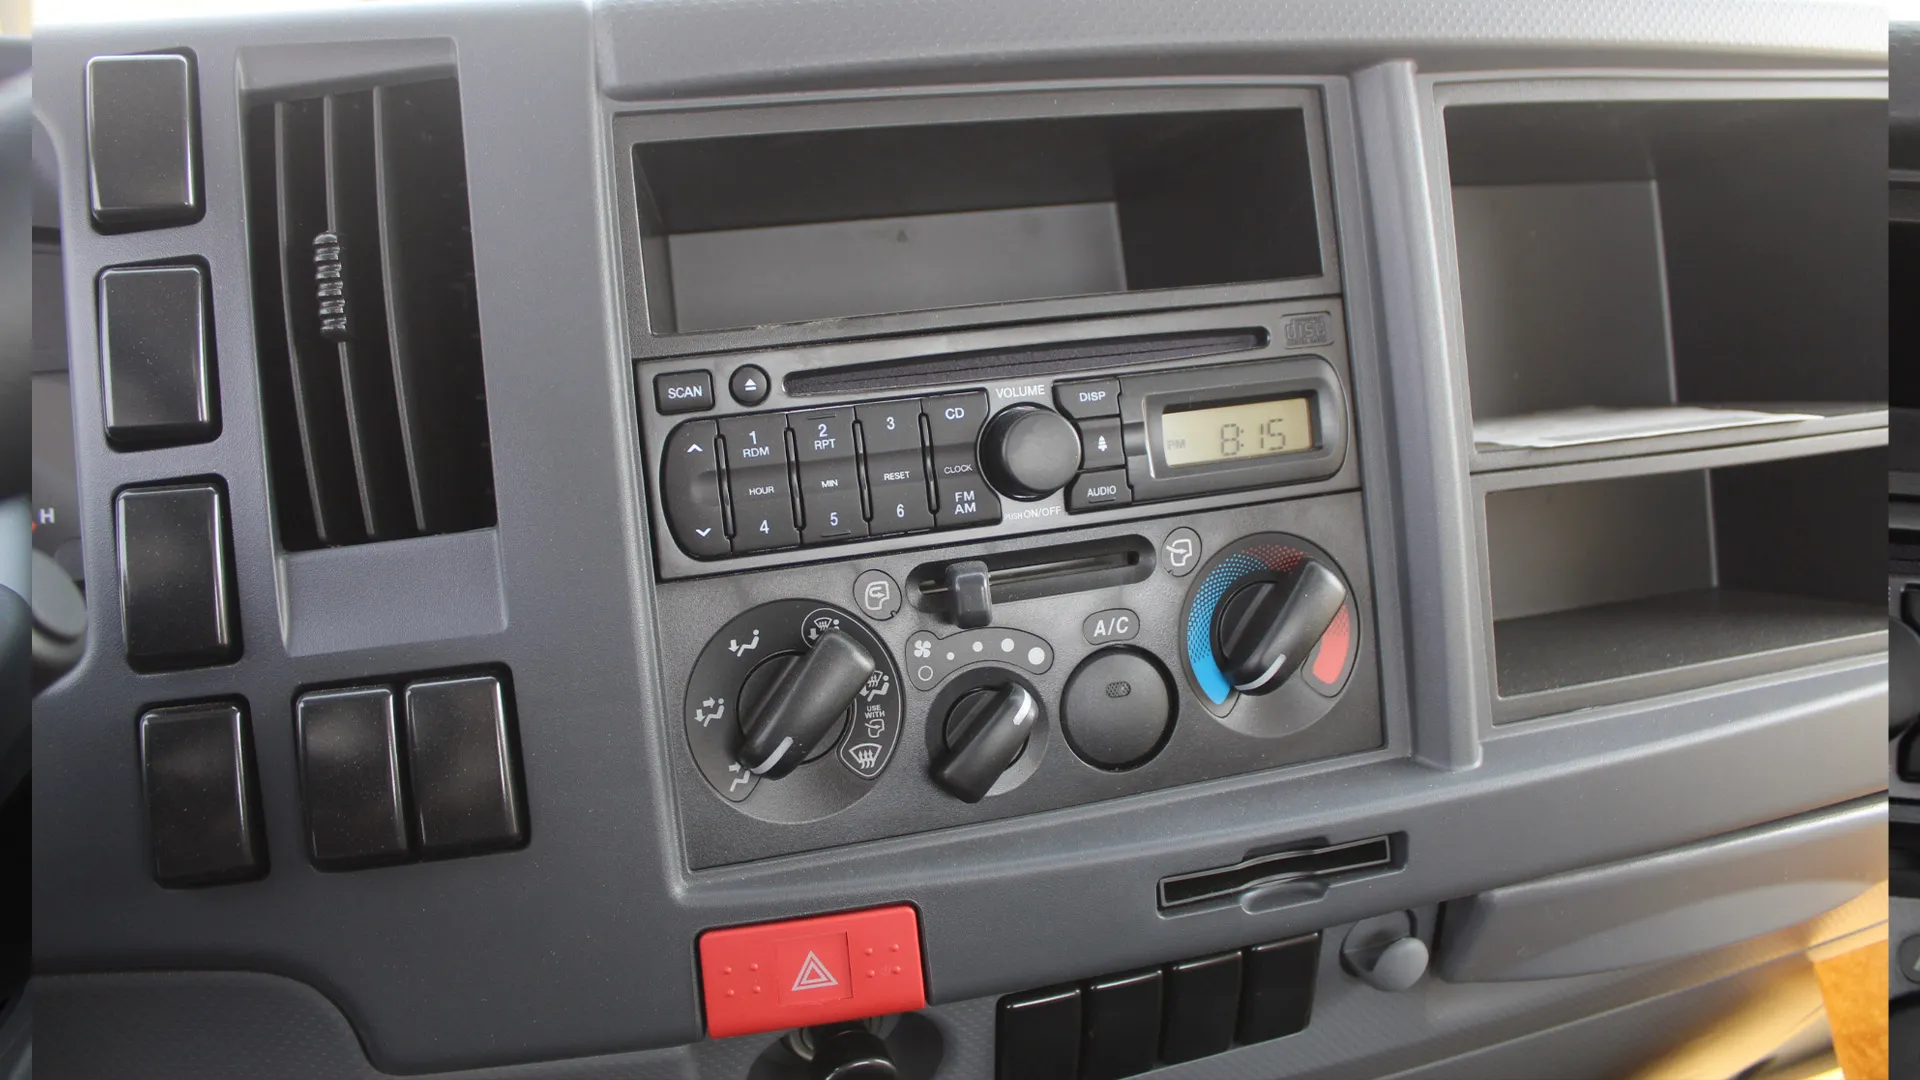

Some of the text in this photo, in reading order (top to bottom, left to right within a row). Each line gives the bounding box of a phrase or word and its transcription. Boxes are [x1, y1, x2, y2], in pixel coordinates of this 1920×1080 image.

[667, 386, 703, 400] SCAN
[995, 384, 1046, 399] VOLUME
[1079, 390, 1106, 404] DISP
[945, 407, 965, 420] CD
[887, 417, 896, 430] 3
[818, 424, 828, 437] 2
[1167, 417, 1286, 457] PM 8:15
[748, 431, 758, 445] 1
[814, 438, 836, 451] RPT
[742, 446, 770, 458] RDM
[944, 463, 973, 474] CLOCK
[883, 470, 910, 481] RESET
[821, 479, 838, 488] MIN
[749, 485, 775, 496] HOUR
[955, 490, 976, 502] FM
[1087, 485, 1117, 498] AUDIO
[896, 504, 905, 518] 6
[954, 502, 977, 515] AM
[1023, 505, 1061, 519] ON/OFF
[40, 507, 56, 524] H
[829, 512, 839, 526] 5
[759, 520, 770, 534] 4
[1093, 616, 1130, 638] A/C
[864, 710, 886, 719] WITH
[866, 704, 882, 712] USE
